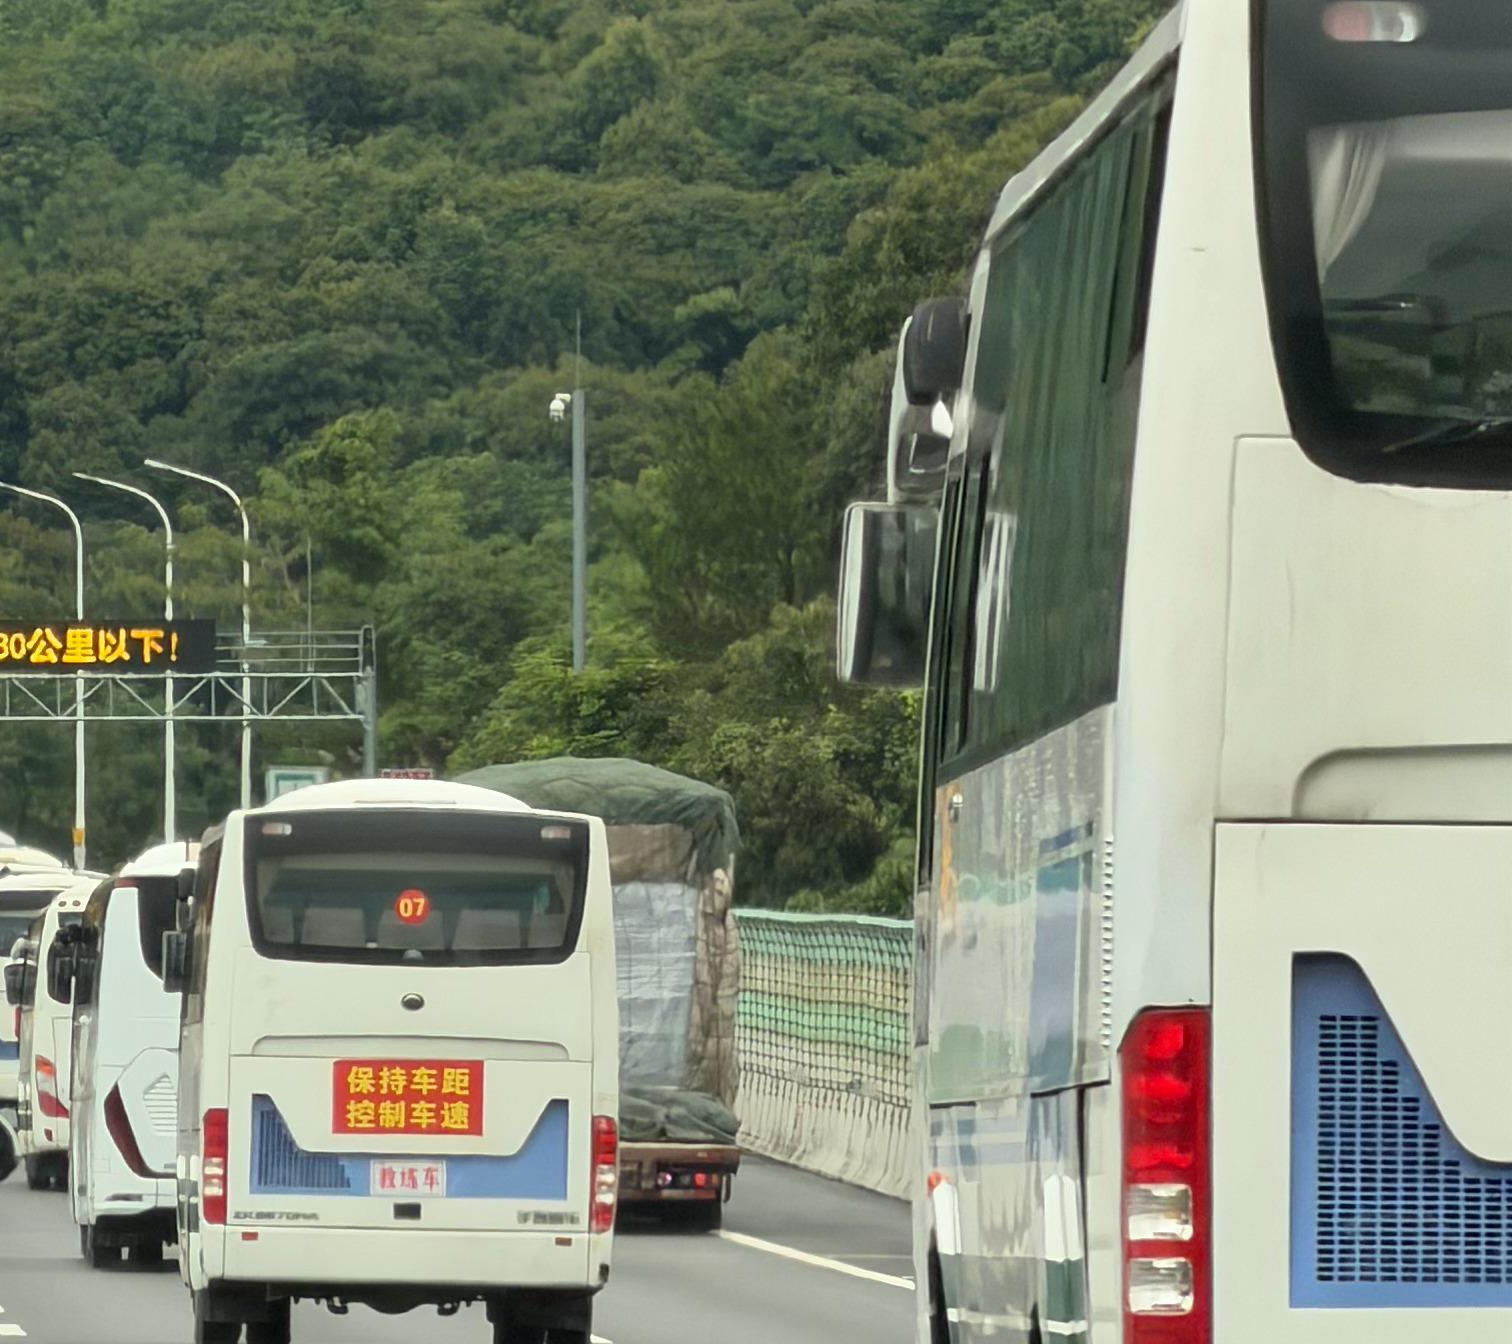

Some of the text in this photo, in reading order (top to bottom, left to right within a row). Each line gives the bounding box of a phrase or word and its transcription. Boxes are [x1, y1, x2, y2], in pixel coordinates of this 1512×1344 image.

[399, 897, 425, 917] 07
[347, 1066, 470, 1095] 保持车距
[346, 1099, 470, 1129] 控制车速
